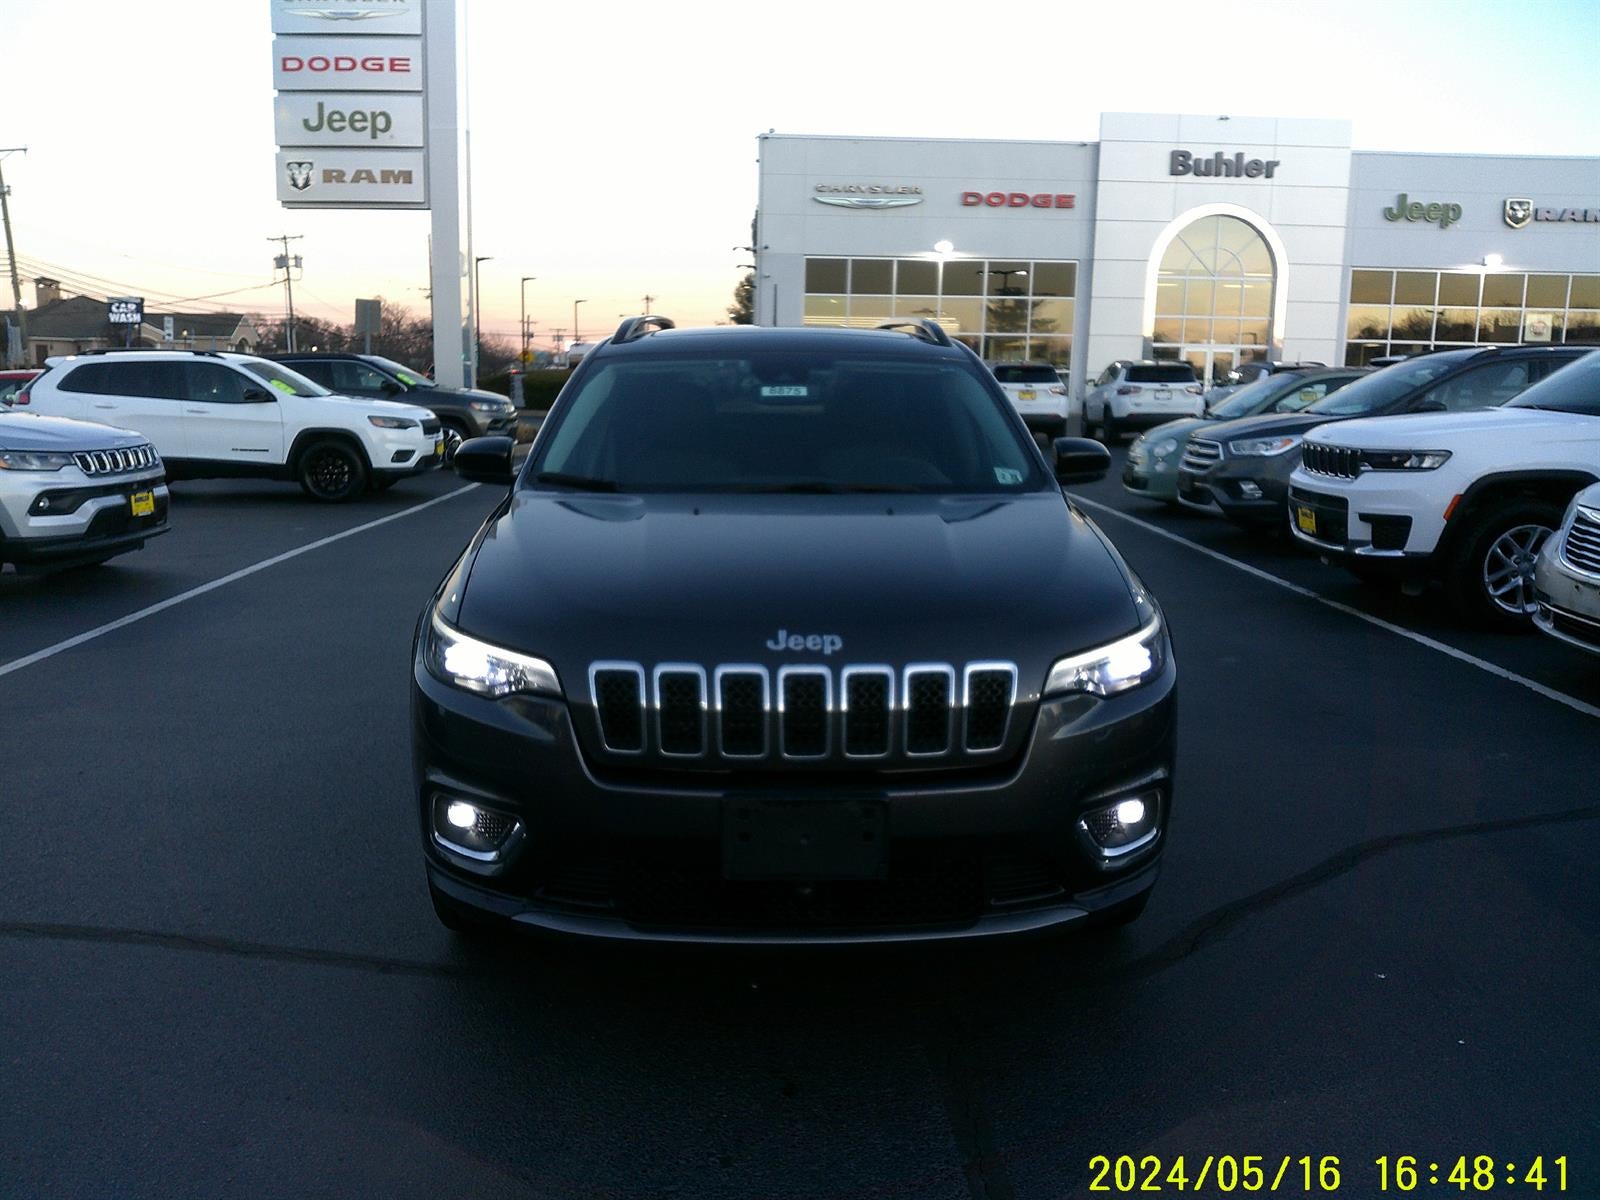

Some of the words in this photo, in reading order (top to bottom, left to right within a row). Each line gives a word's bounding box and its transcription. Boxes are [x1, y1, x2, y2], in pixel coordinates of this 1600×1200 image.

[281, 56, 411, 72] DODGE
[302, 101, 392, 139] Jeep
[1169, 149, 1280, 178] Buhler
[322, 168, 413, 184] RAM
[815, 184, 922, 195] CHRYSLER
[961, 191, 1076, 209] DODGE
[1383, 192, 1463, 229] Jeep
[111, 302, 138, 313] CAR
[108, 312, 142, 323] WASH
[766, 629, 843, 655] Jeep
